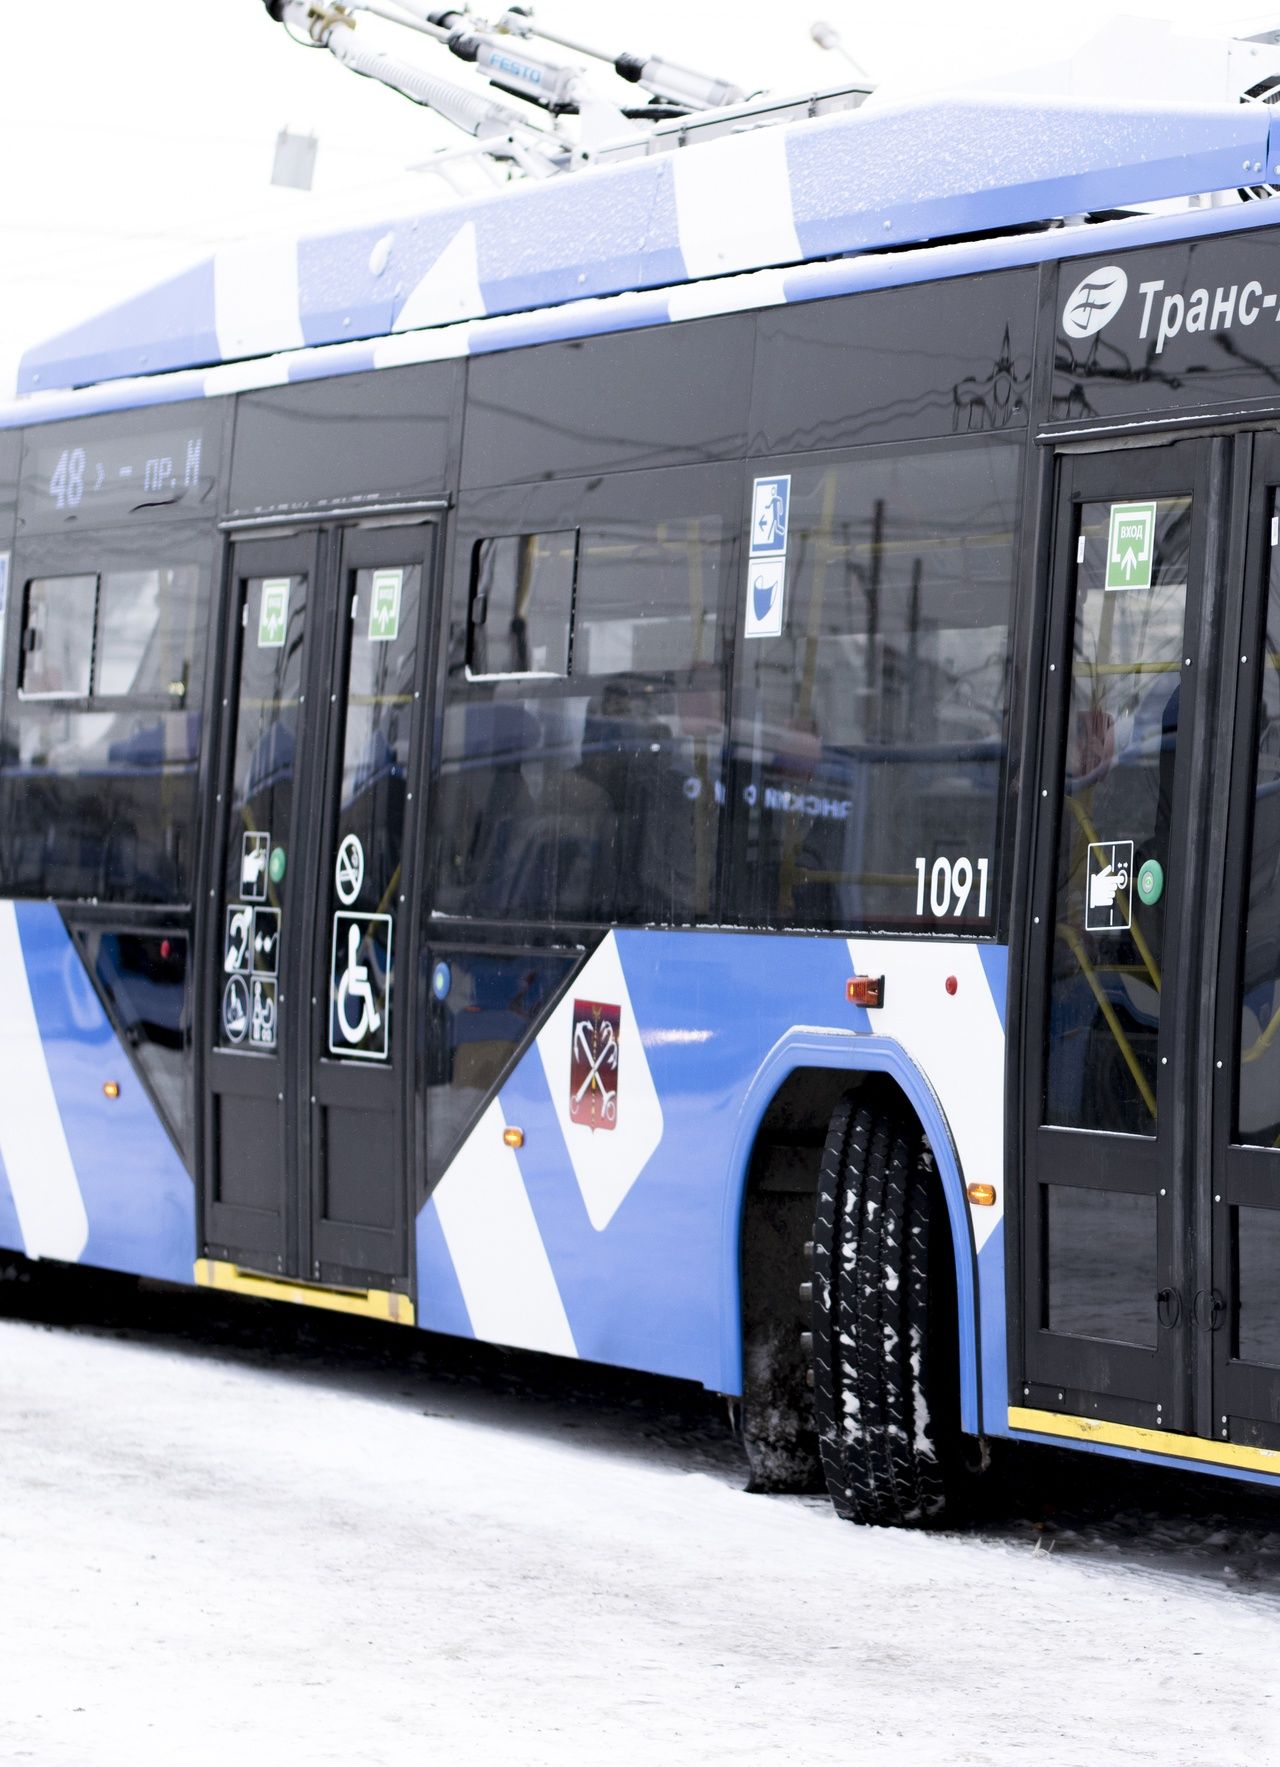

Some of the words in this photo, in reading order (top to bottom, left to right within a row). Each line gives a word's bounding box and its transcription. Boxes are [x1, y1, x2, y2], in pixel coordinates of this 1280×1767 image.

[489, 53, 541, 84] FESTO
[49, 448, 86, 509] 48
[1120, 525, 1143, 541] ВХОД
[915, 856, 989, 917] 1091
